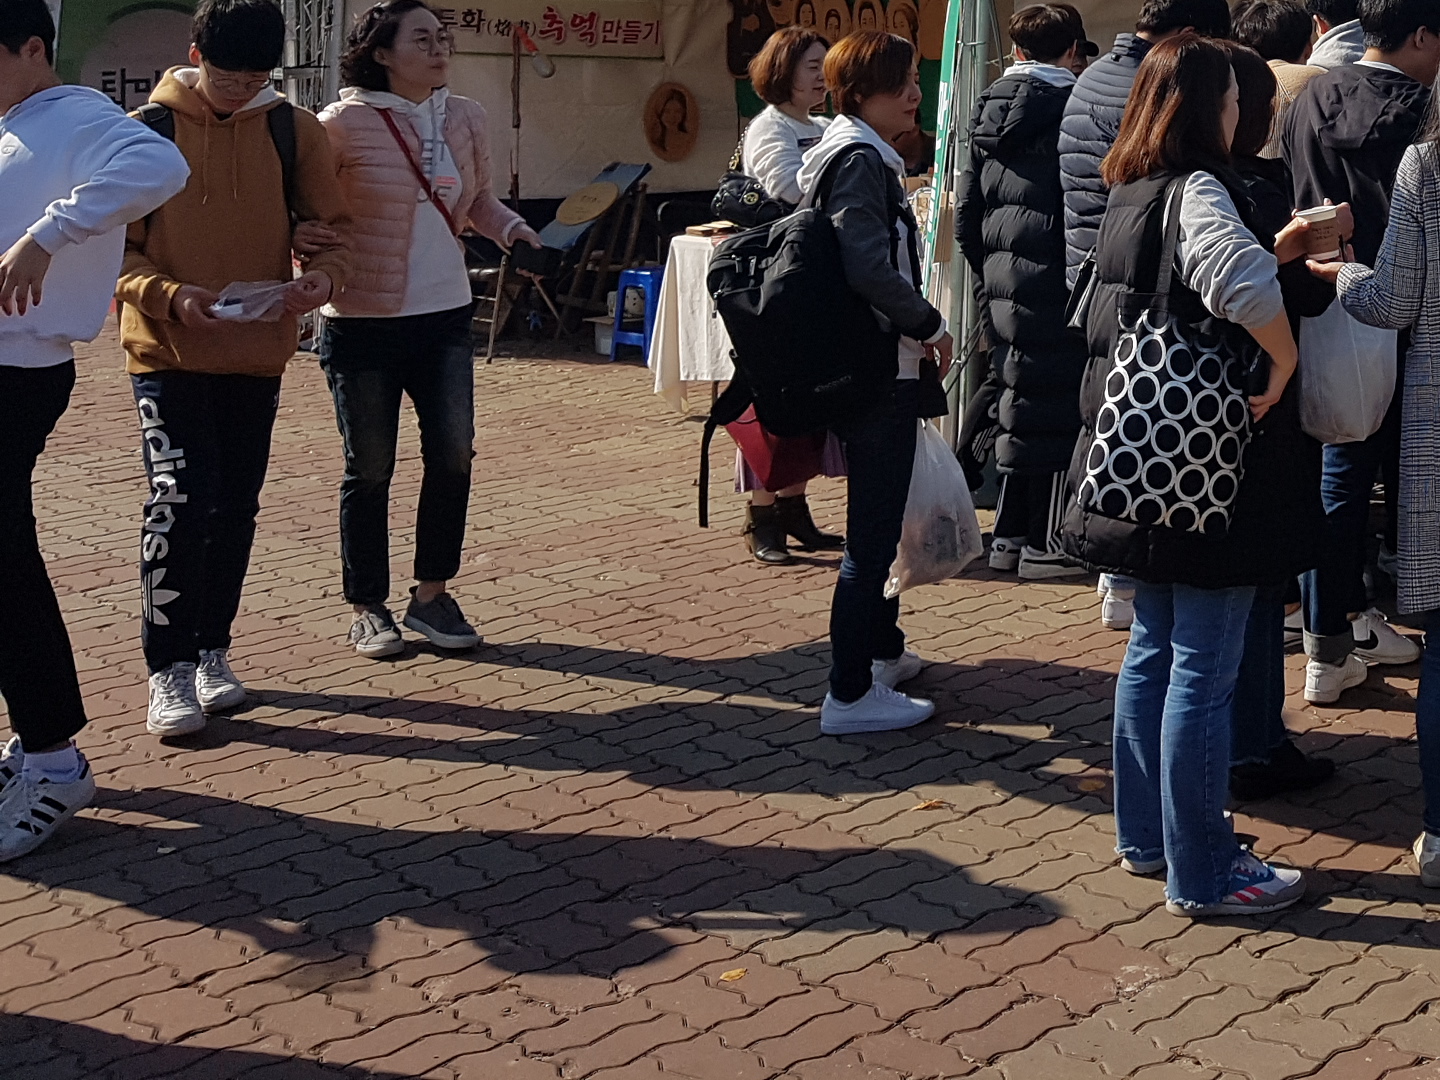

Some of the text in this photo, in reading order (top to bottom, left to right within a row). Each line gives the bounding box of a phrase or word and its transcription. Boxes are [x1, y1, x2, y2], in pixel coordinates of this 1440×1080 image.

[538, 5, 598, 46] 추억
[602, 19, 661, 45] 만들기
[139, 397, 188, 562] adidas
